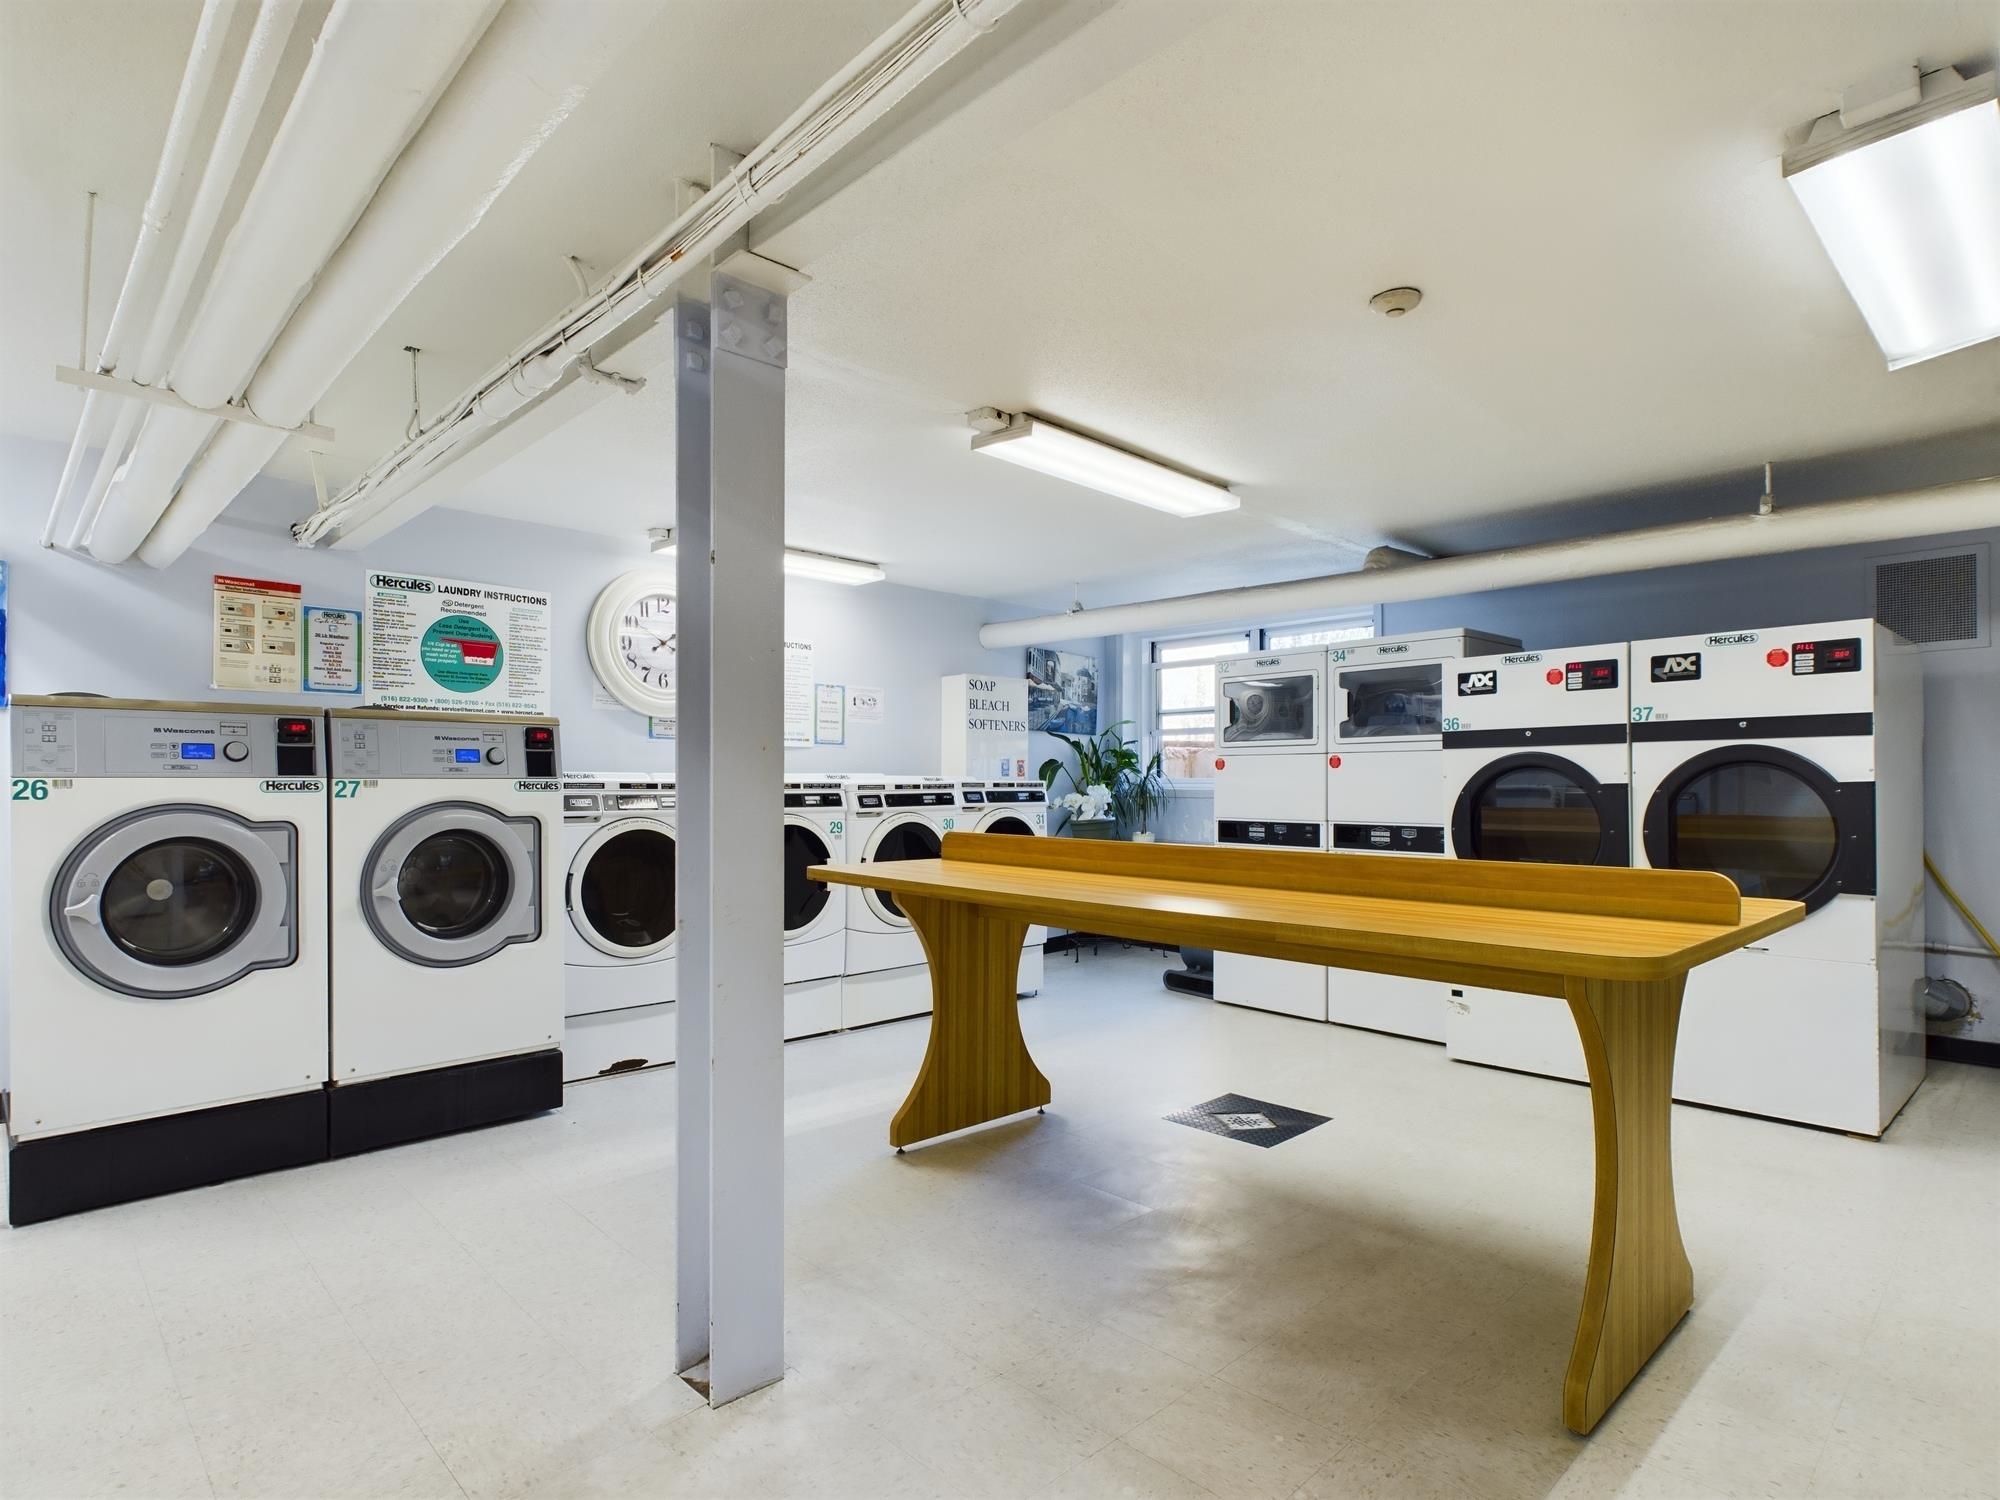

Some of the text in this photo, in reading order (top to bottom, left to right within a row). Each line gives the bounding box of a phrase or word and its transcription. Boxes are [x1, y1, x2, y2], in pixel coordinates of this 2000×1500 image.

[376, 575, 548, 606] Hercules LAUNDRY INSTRUCTIONS
[440, 606, 487, 617] Recommended
[454, 601, 484, 610] Detergent
[640, 601, 648, 618] 11
[657, 597, 670, 614] 12
[323, 612, 346, 620] Hercules
[625, 616, 638, 628] 10
[454, 624, 481, 632] Detergent
[622, 636, 632, 650] 9
[1709, 634, 1755, 645] Hercules
[1332, 650, 1346, 662] 34
[1379, 646, 1408, 654] Hercules
[626, 652, 637, 669] 8
[1256, 659, 1280, 667] Hercules
[1504, 654, 1540, 664] Hercules
[1664, 656, 1696, 673] ADC
[1218, 662, 1230, 673] 32
[642, 666, 652, 683] 7
[658, 672, 668, 688] 6
[1468, 672, 1494, 688] ADC
[968, 678, 996, 692] SOAP
[968, 698, 1010, 712] BLEACH
[1632, 706, 1654, 722] 37
[968, 718, 1026, 732] SOFTENERS
[1443, 718, 1460, 731] 36
[12, 779, 48, 800] 26
[266, 780, 320, 790] Hercules
[334, 780, 360, 798] 27
[518, 781, 559, 790] Hercules
[943, 818, 954, 830] 30
[1036, 814, 1044, 824] 31
[830, 821, 842, 834] 29
